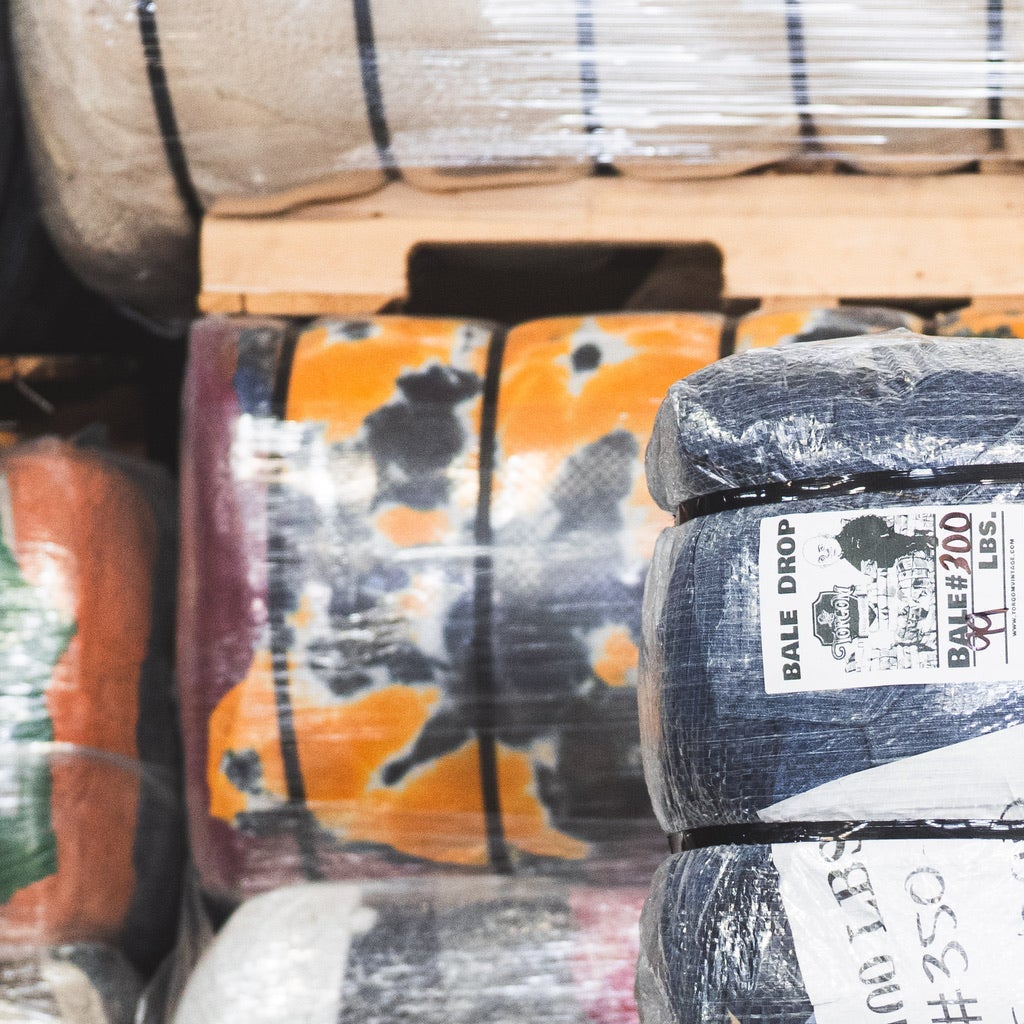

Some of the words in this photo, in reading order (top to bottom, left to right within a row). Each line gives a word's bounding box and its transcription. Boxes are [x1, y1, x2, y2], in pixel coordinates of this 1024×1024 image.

[776, 518, 797, 594] DROP
[938, 511, 973, 575] 300
[978, 511, 998, 570] LBS.
[779, 609, 801, 681] BALE
[831, 584, 857, 660] TORGOM
